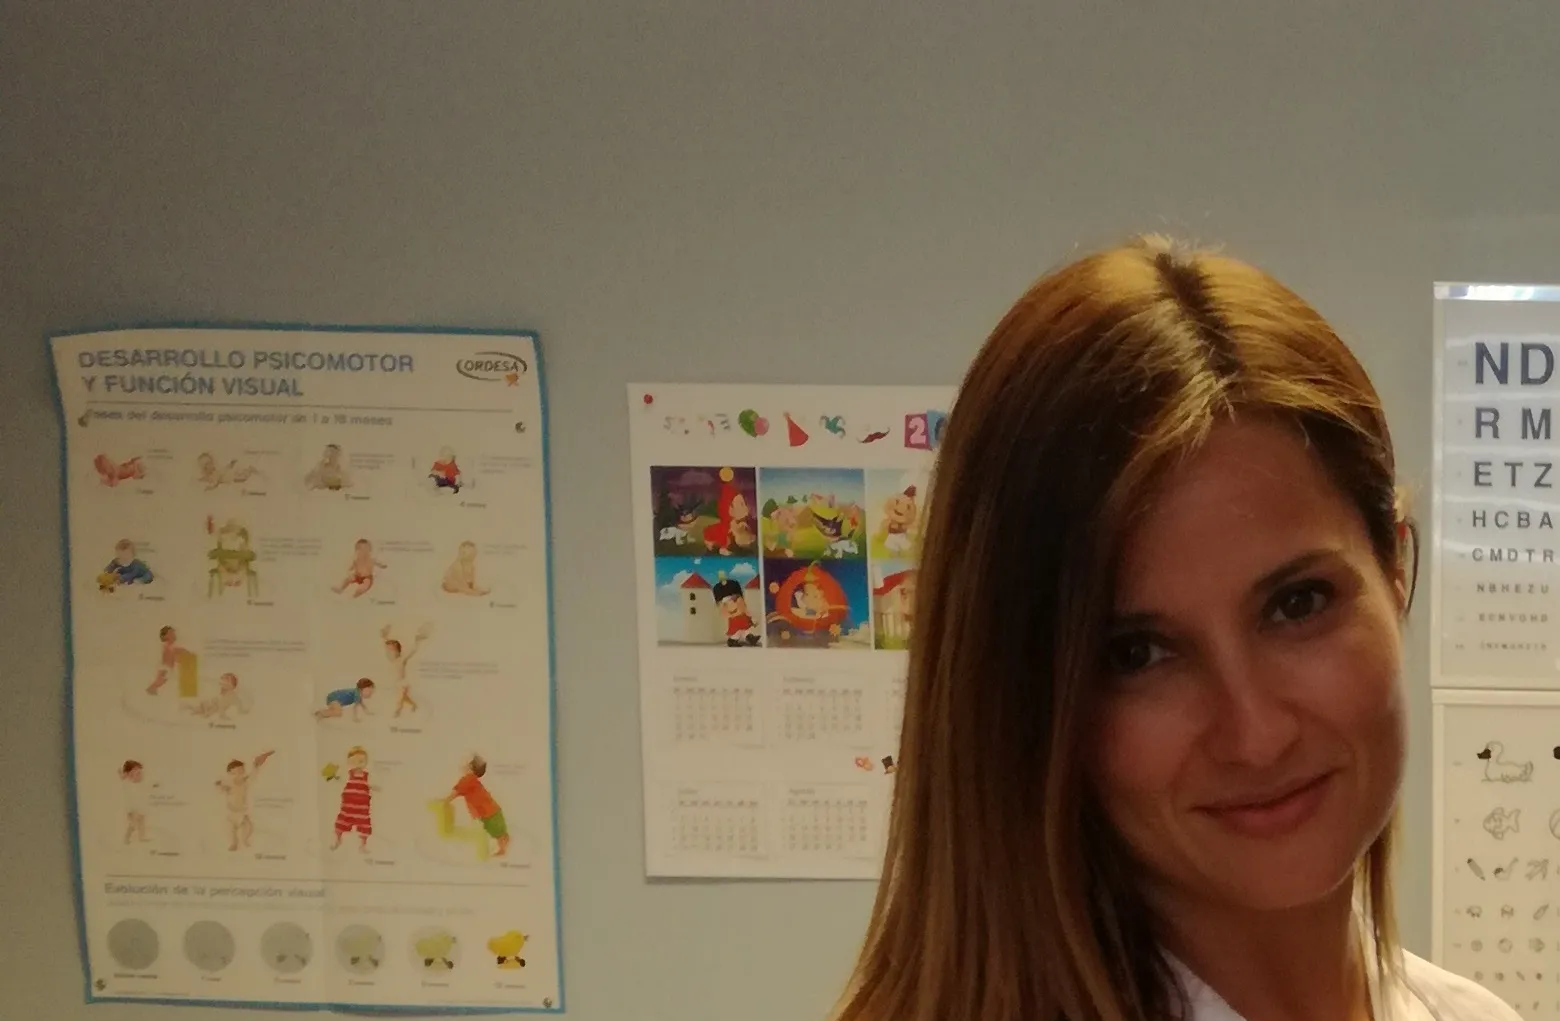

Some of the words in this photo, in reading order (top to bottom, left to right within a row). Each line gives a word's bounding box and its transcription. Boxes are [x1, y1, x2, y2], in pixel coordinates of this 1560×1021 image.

[78, 349, 246, 370] DESARROLLO
[253, 351, 414, 373] PSICOMOTOR
[463, 360, 519, 372] ORDESA
[81, 376, 95, 392] Y
[104, 372, 214, 395] FUNCIÓN
[224, 377, 304, 396] VISUAL
